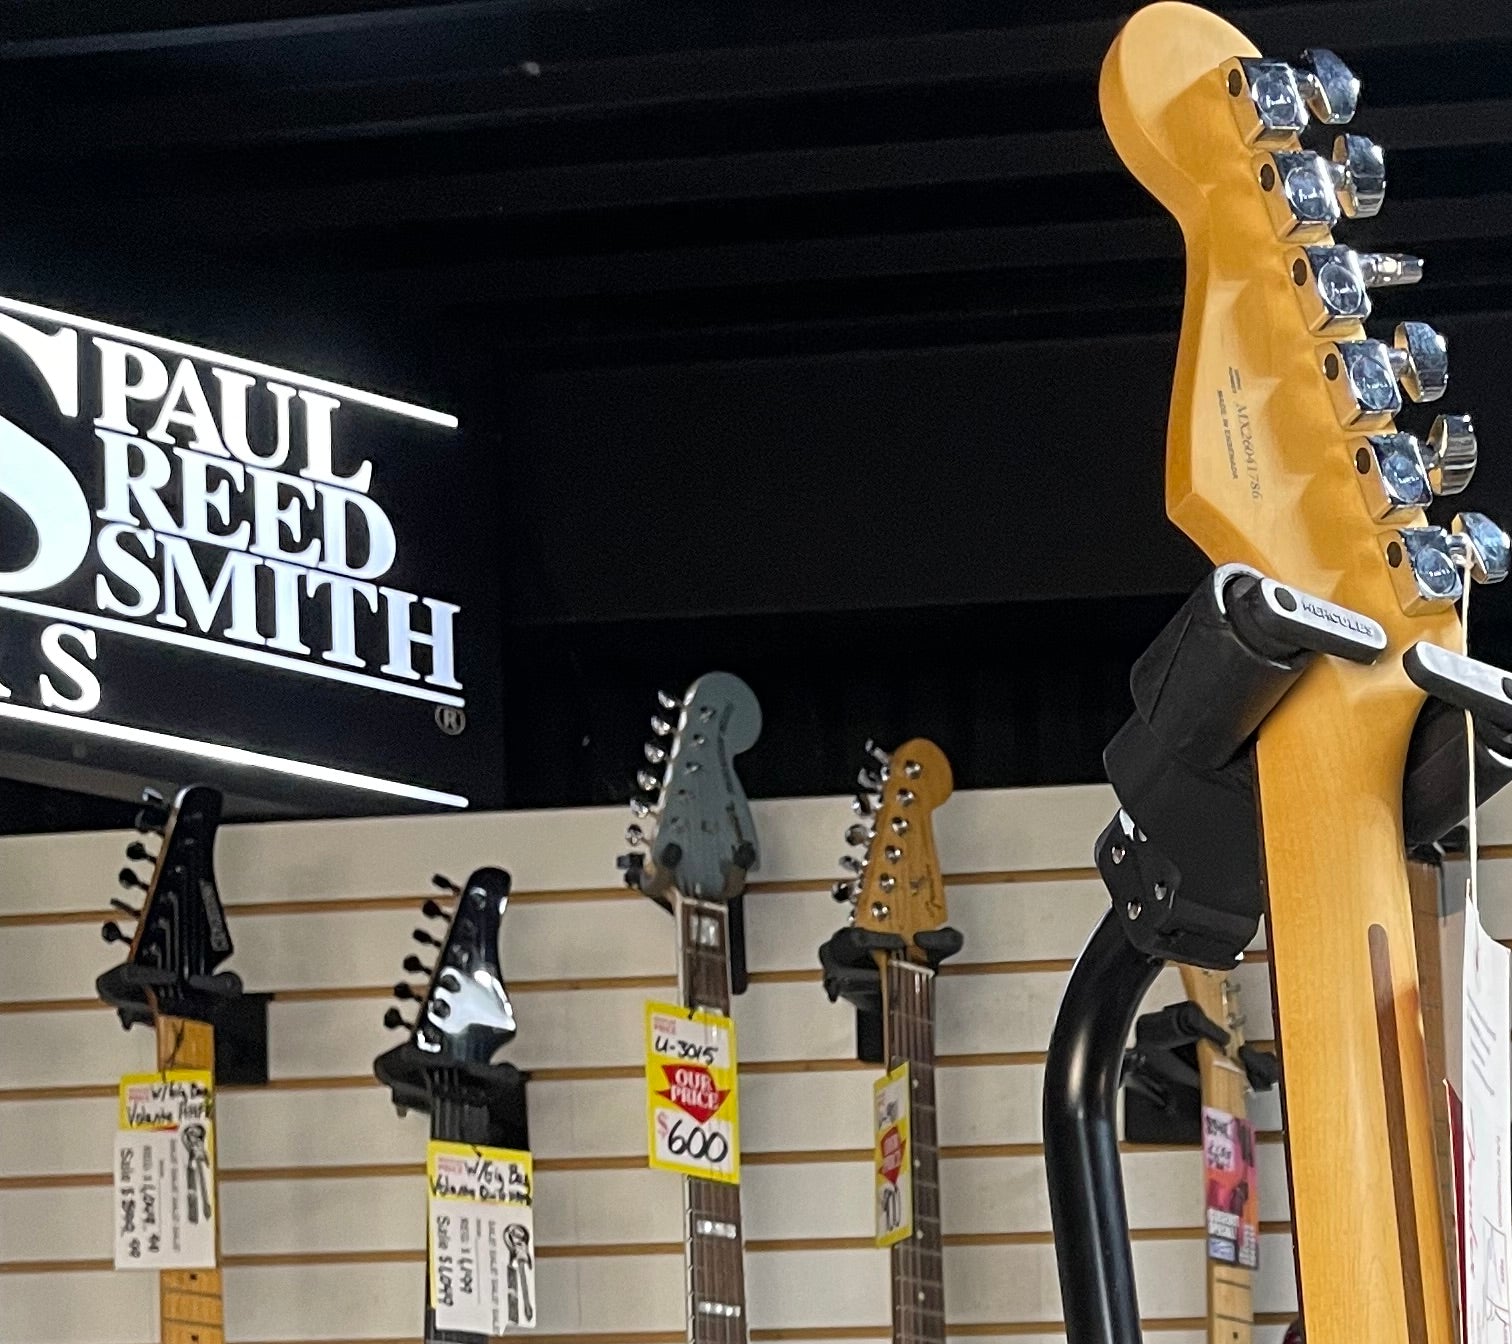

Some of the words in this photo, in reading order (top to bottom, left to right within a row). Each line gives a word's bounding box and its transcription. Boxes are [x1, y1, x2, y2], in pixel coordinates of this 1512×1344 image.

[92, 336, 373, 493] PAUL
[95, 428, 397, 581] REED
[96, 522, 465, 691] SMITH
[669, 1083, 720, 1112] PRICE
[674, 1068, 712, 1093] OUR
[656, 1112, 728, 1164] $600
